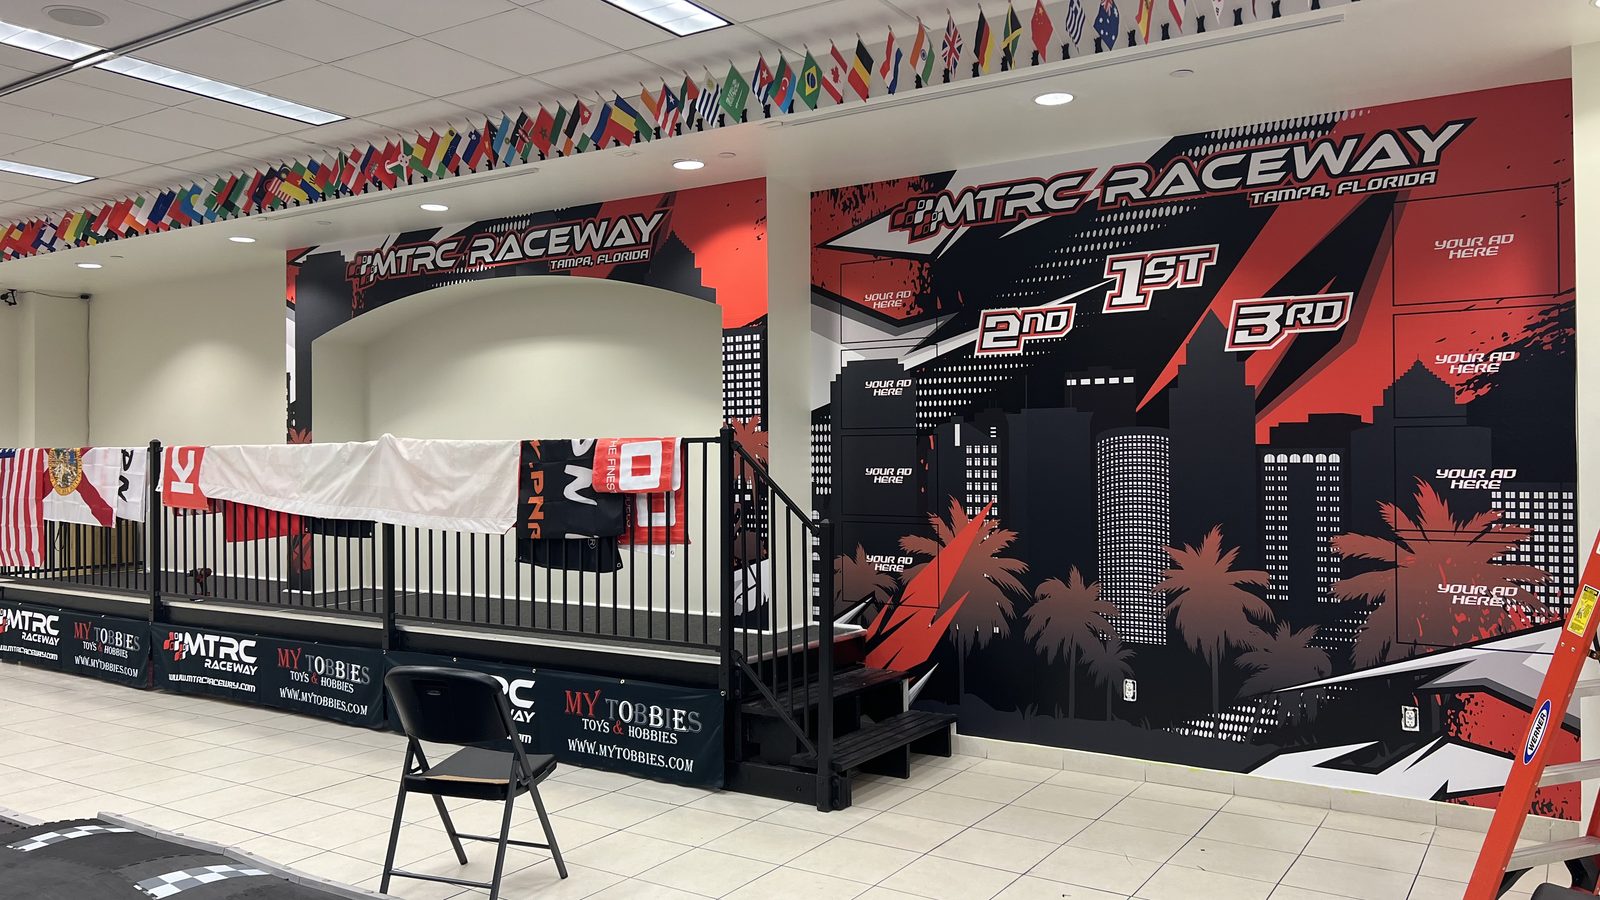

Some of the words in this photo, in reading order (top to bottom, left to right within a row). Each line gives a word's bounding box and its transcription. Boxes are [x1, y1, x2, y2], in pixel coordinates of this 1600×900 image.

[936, 175, 1084, 224] MTRC
[1104, 123, 1465, 204] RACEWAY
[1251, 185, 1330, 204] TAMPA,
[1337, 171, 1436, 194] FLORIDA
[373, 240, 460, 277] MTRC
[470, 213, 664, 265] RACEWAY
[1434, 236, 1484, 250] YOUR
[1488, 233, 1515, 245] AD
[550, 256, 594, 270] TAMPA,
[596, 249, 649, 264] FLORIDA
[1448, 246, 1499, 259] HERE
[1106, 248, 1215, 311] 1ST
[864, 291, 895, 302] YOUR
[896, 290, 911, 300] AD
[873, 299, 903, 309] HERE
[978, 307, 1071, 352] 2ND
[1226, 296, 1348, 348] 3RD
[1434, 352, 1485, 364] YOUR
[1489, 351, 1516, 362] AD
[1449, 363, 1500, 374] HERE
[865, 379, 895, 389] YOUR
[896, 379, 912, 388] AD
[873, 387, 903, 396] HERE
[865, 467, 896, 476] YOUR
[897, 467, 912, 476] AD
[873, 475, 904, 484] HERE
[1435, 468, 1486, 479] YOUR
[1490, 468, 1517, 479] AD
[1450, 479, 1502, 489] HERE
[866, 554, 896, 564] YOUR
[898, 556, 913, 565] AD
[874, 563, 905, 572] HERE
[1437, 583, 1488, 595] YOUR
[1492, 586, 1518, 597] AD
[1452, 595, 1503, 607] HERE
[6, 609, 59, 636] MTRC
[22, 632, 60, 646] RACEWAY
[73, 621, 92, 640] MY
[94, 627, 140, 652] TOBBIES
[82, 641, 97, 652] TOYS
[97, 642, 103, 653] &
[104, 645, 128, 659] HOBBIES
[183, 631, 258, 664] MTRC
[74, 655, 139, 678] WWW.MYTOBBIES.COM
[204, 658, 258, 676] RACEWAY
[277, 647, 301, 670] MY
[305, 654, 371, 685] TOBBIES
[290, 670, 310, 683] TOYS
[310, 671, 319, 685] &
[320, 676, 354, 694] HOBBIES
[279, 686, 368, 716] WWW.MYTOBBIES.COM
[564, 689, 600, 718] MY
[605, 698, 703, 733] TOBBIES
[581, 717, 610, 734] TOYS
[612, 719, 624, 736] &
[628, 725, 678, 745] HOBBIES
[1528, 712, 1547, 751] WERNER
[567, 737, 694, 773] WWW.MYTOBBIES.COM
